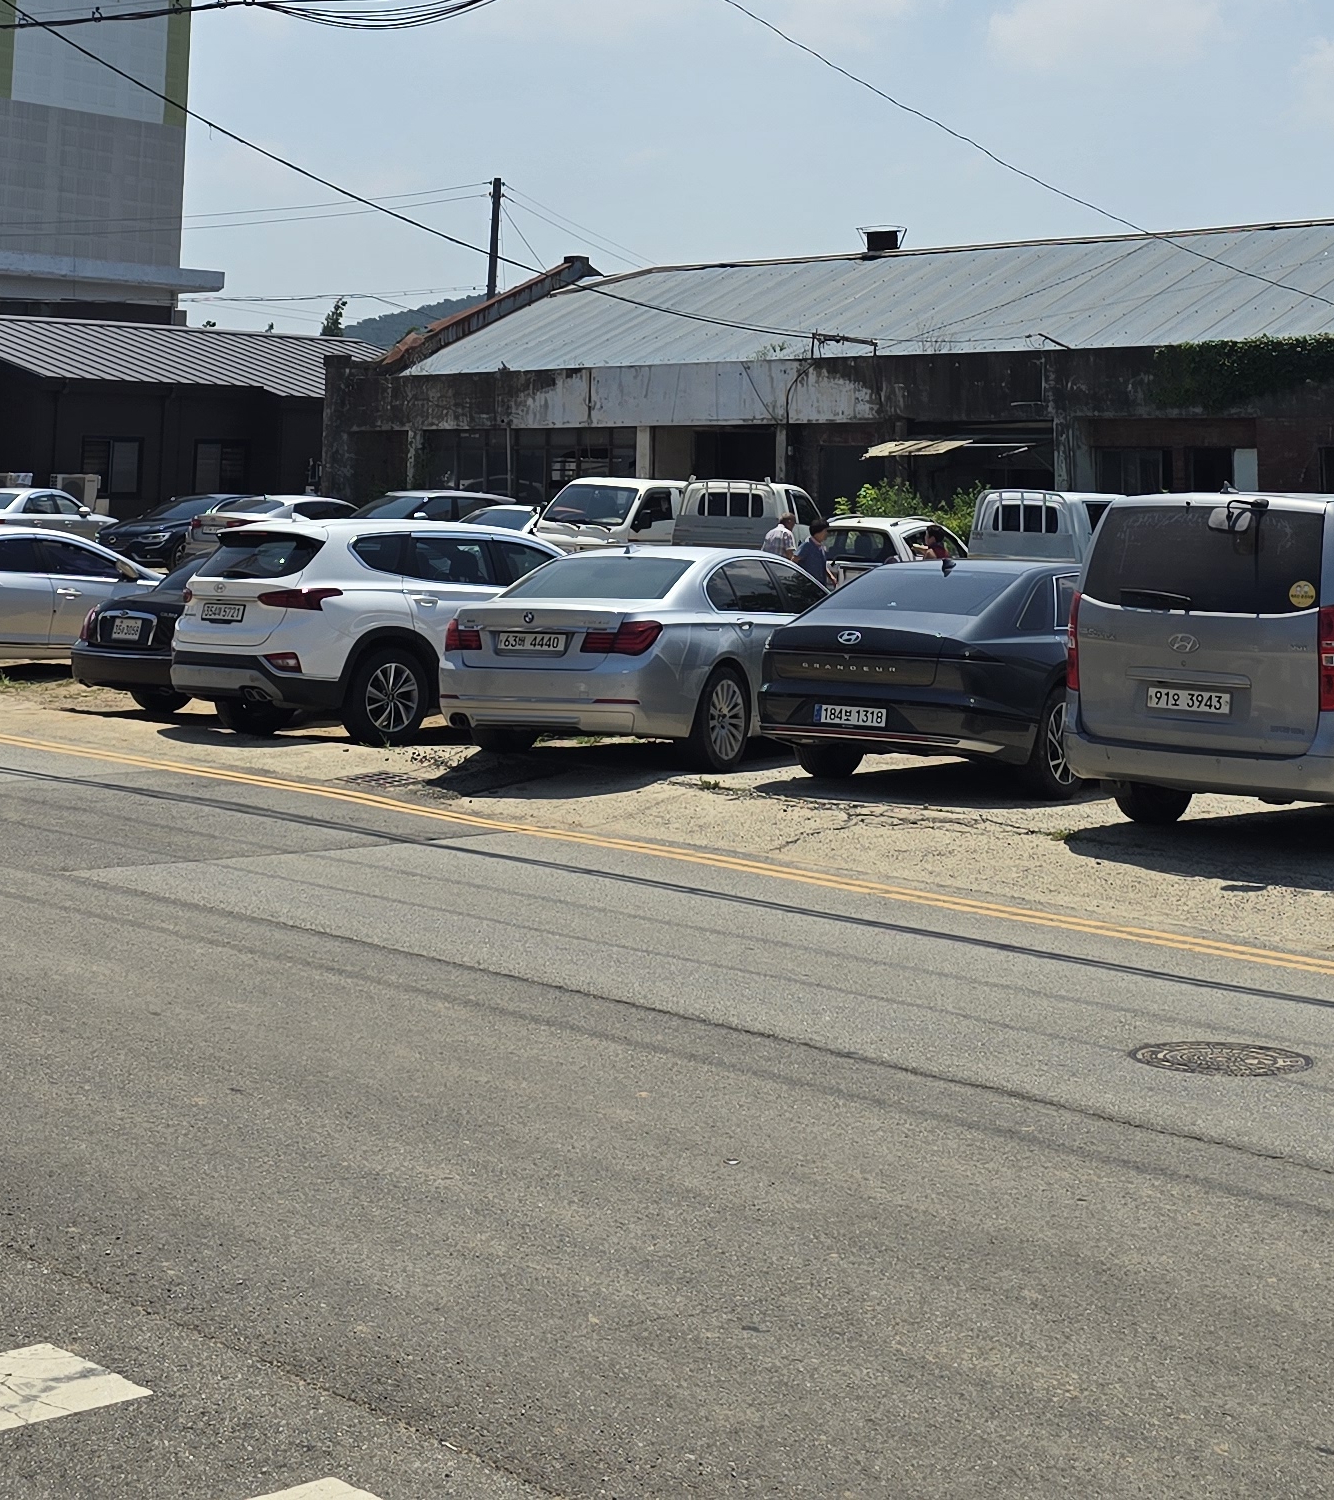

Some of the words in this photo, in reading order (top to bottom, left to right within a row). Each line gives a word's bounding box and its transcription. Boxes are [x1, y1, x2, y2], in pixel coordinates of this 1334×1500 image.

[529, 636, 560, 649] 4440
[802, 662, 896, 673] GRANDEUR
[1154, 690, 1180, 707] 91오
[1186, 692, 1223, 711] 3943
[823, 707, 853, 722] 184보
[855, 709, 884, 725] 1318
